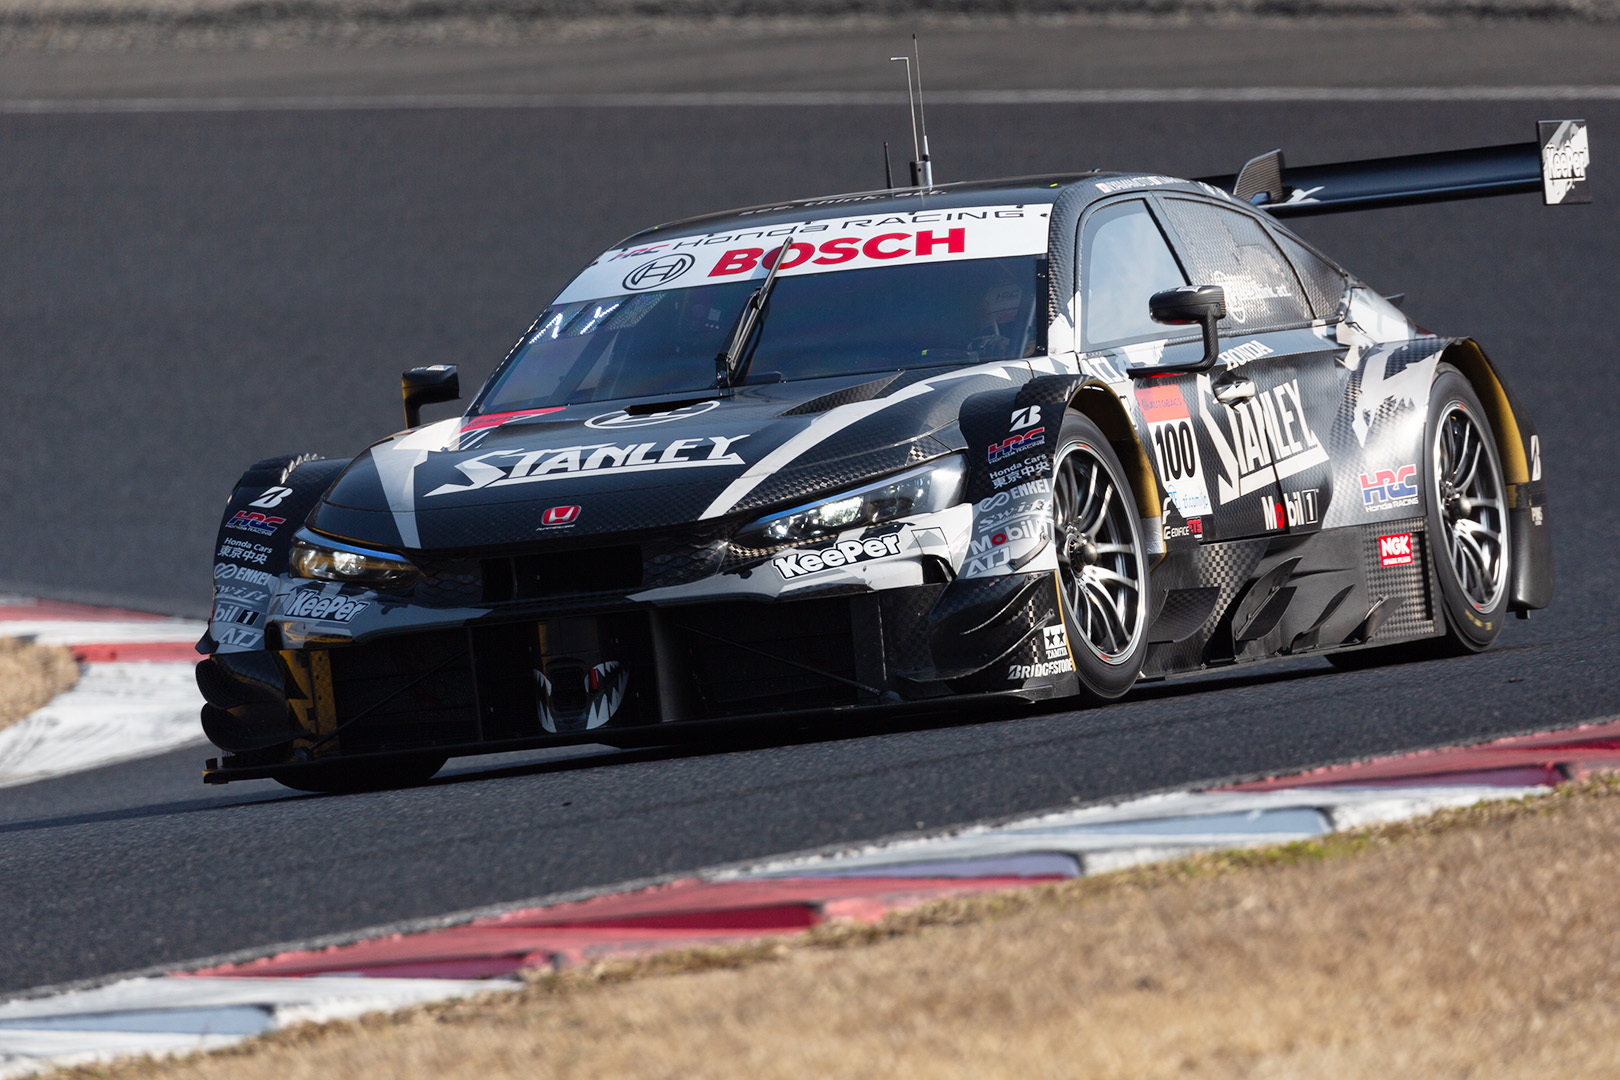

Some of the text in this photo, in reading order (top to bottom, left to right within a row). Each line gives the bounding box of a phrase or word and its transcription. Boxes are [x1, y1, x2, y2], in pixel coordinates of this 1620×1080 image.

[673, 223, 830, 250] Honda
[842, 209, 1024, 229] RACING
[707, 227, 966, 278] BOSCH
[1219, 340, 1274, 371] HONDA
[988, 427, 1045, 462] HRC
[1155, 421, 1196, 482] 100
[1197, 373, 1329, 505] STANLEY
[424, 434, 751, 497] STANLEY
[990, 454, 1047, 479] Honda Cars
[992, 461, 1051, 489] 東京中央
[1010, 479, 1050, 499] ENKEI
[1359, 464, 1418, 506] HRC
[228, 510, 287, 534] HRC
[1262, 491, 1304, 531] Mobil
[1365, 503, 1393, 513] Honda
[224, 537, 273, 554] Honda Cars
[970, 519, 1033, 555] Mobil
[1380, 535, 1410, 557] NGK
[218, 545, 268, 565] 東京中央
[774, 534, 900, 579] KeePer
[234, 566, 273, 586] ENKEI
[285, 590, 369, 622] KeePer
[1007, 658, 1073, 680] BRIDGESTONE
